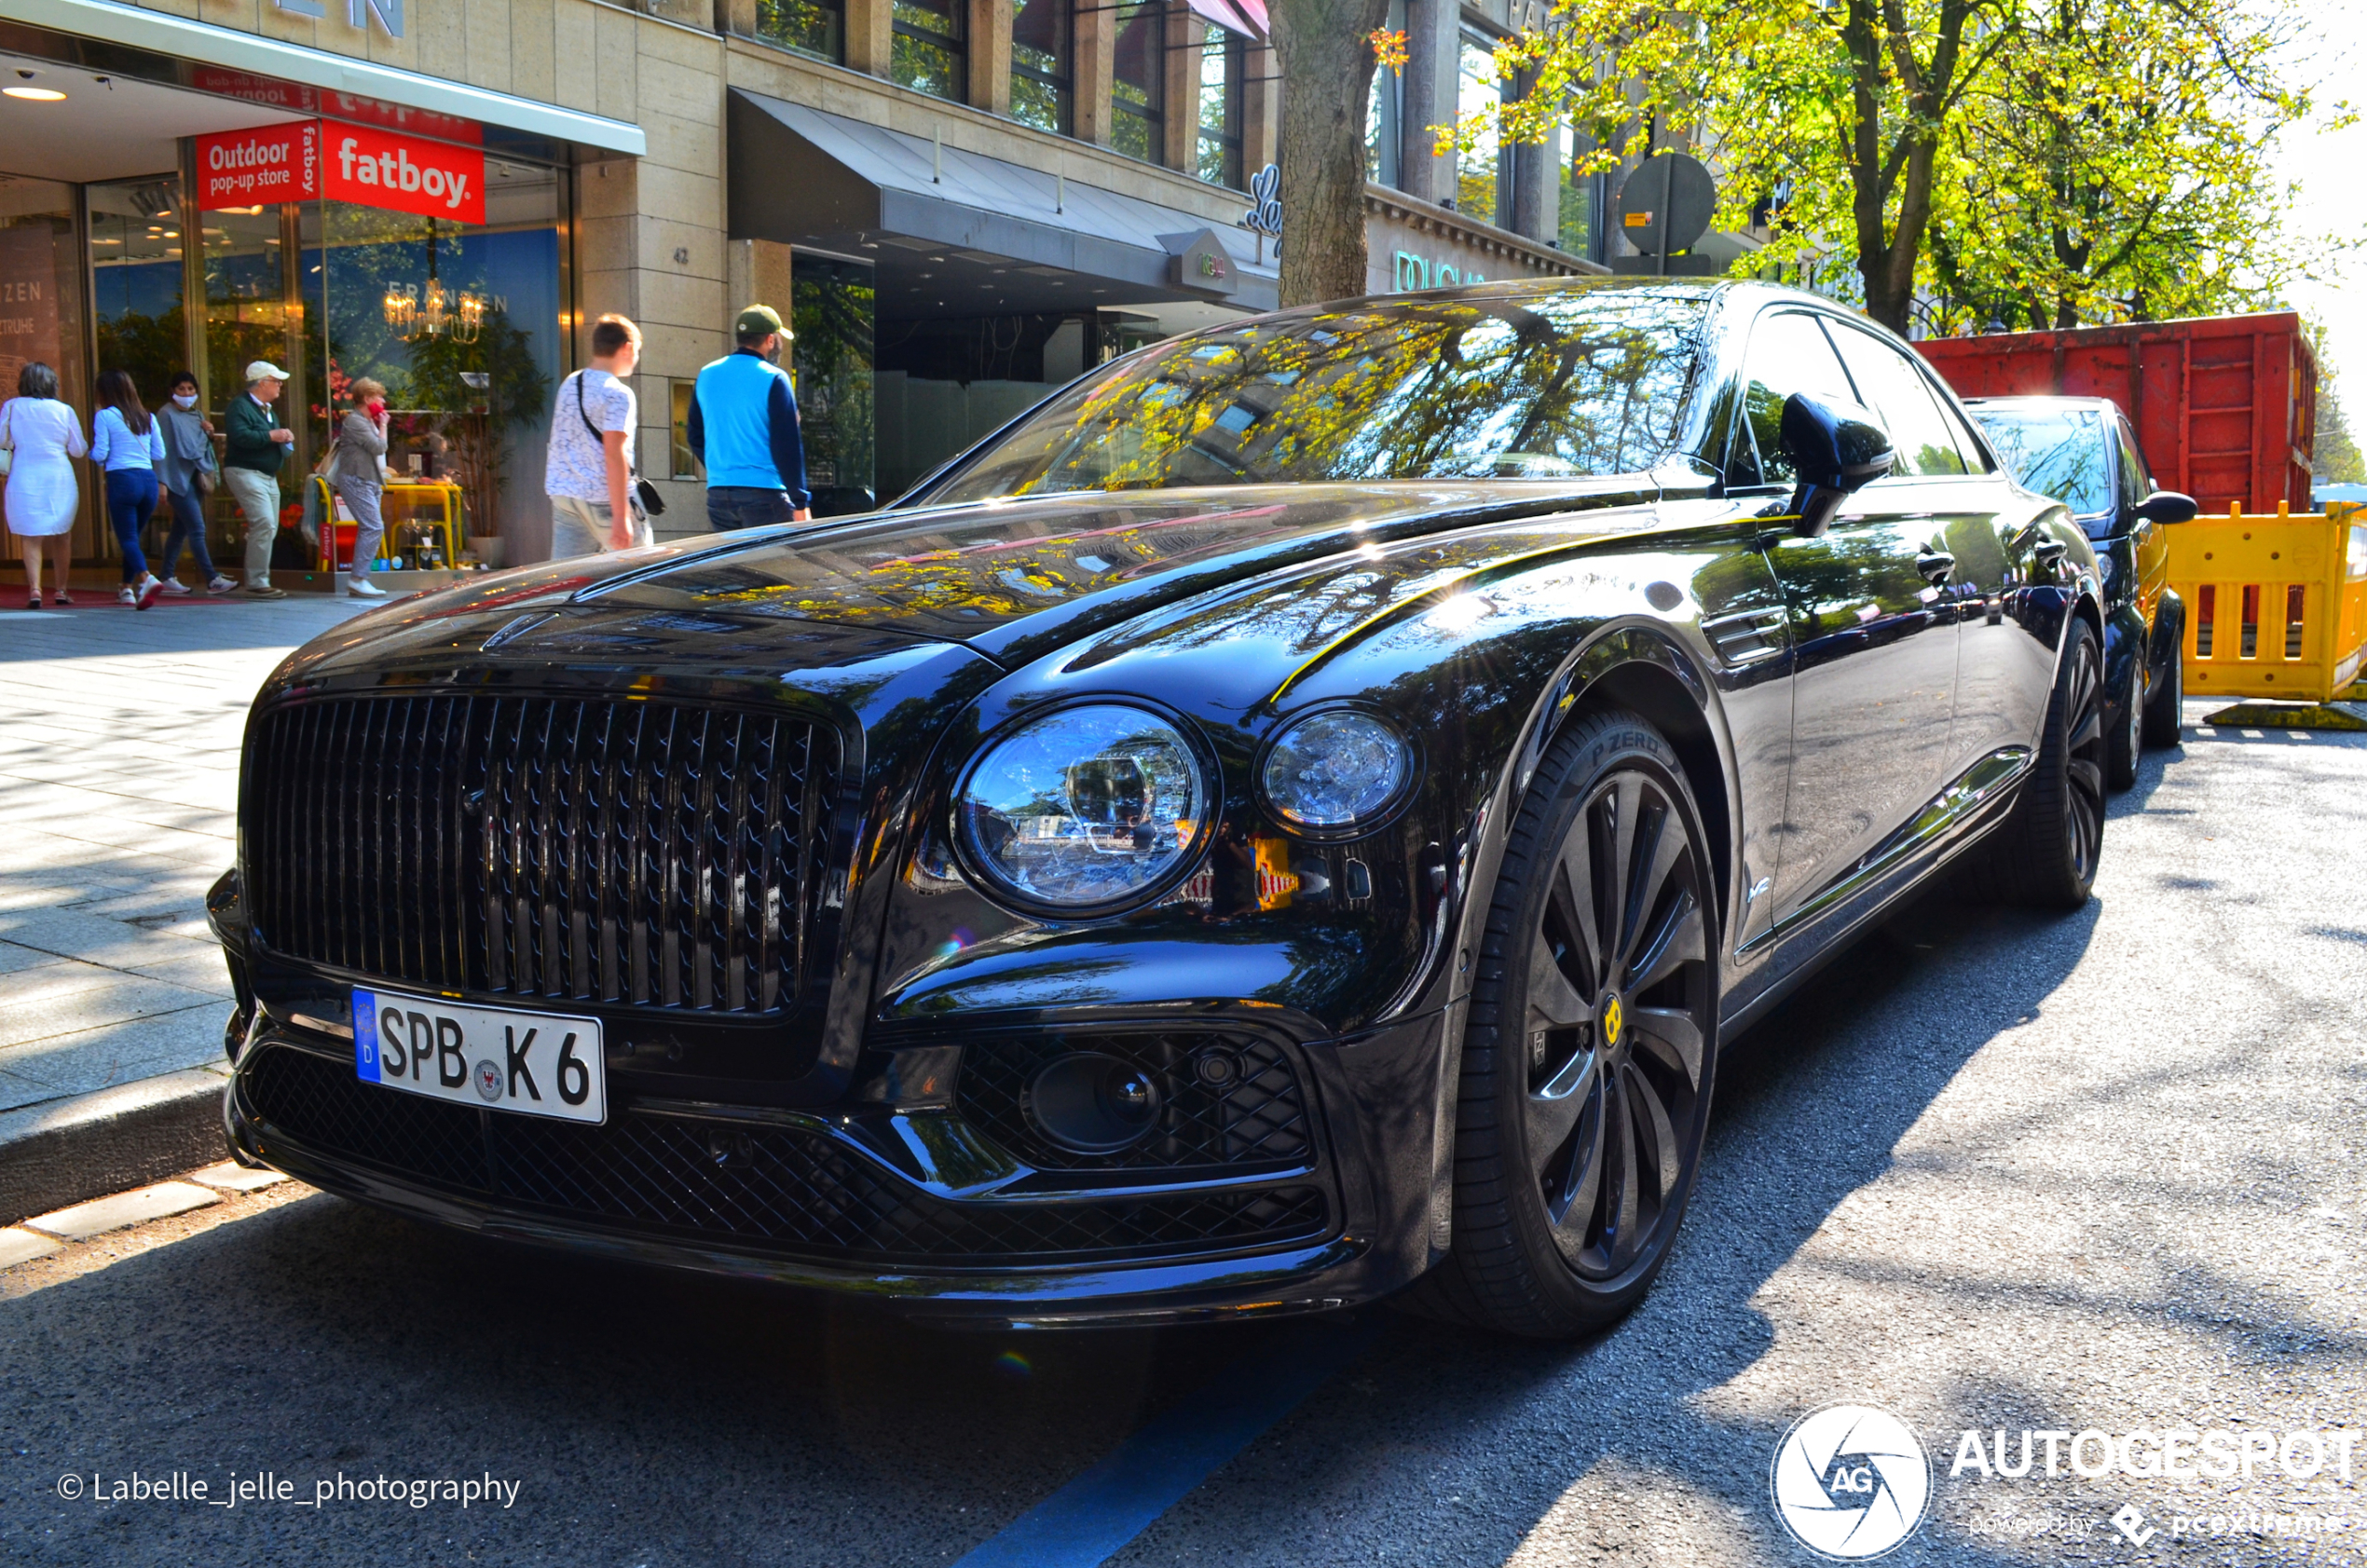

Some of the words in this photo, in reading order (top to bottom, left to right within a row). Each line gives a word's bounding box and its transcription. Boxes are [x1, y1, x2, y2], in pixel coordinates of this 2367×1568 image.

[210, 139, 289, 170] Outdoor
[210, 173, 255, 197] pop-up
[257, 169, 290, 186] store
[1593, 743, 1604, 767] P
[1608, 731, 1658, 754] ZERO
[363, 1044, 373, 1064] D
[380, 1007, 468, 1088] SPB
[505, 1026, 542, 1100] K
[556, 1032, 590, 1106] 6
